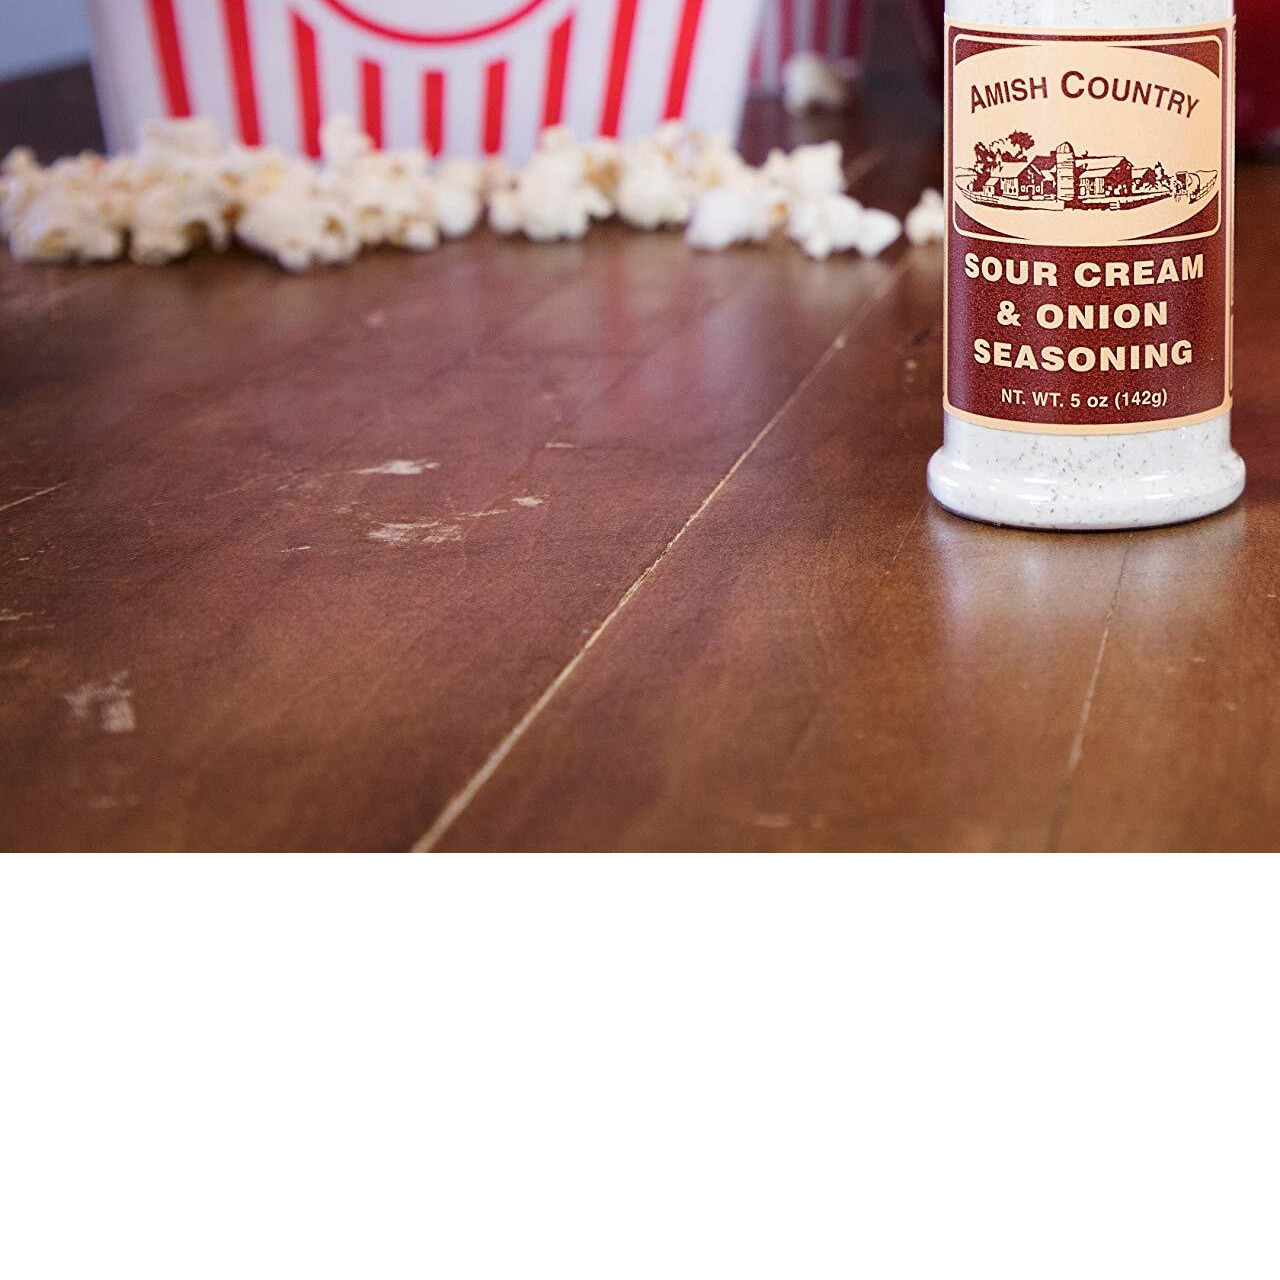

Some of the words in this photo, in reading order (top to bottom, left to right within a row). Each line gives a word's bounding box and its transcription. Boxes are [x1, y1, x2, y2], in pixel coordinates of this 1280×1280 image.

[970, 76, 1049, 114] AMISH
[1060, 70, 1201, 119] COUNTRY
[964, 252, 1058, 287] SOUR
[1074, 253, 1204, 288] CREAM
[996, 300, 1021, 327] &
[1036, 300, 1168, 330] ONION
[973, 338, 1193, 372] SEASONING
[1001, 388, 1026, 405] NT.
[1032, 391, 1064, 407] WT.
[1070, 393, 1080, 408] 5
[1087, 394, 1108, 408] oz
[1114, 388, 1168, 410] (142g)
